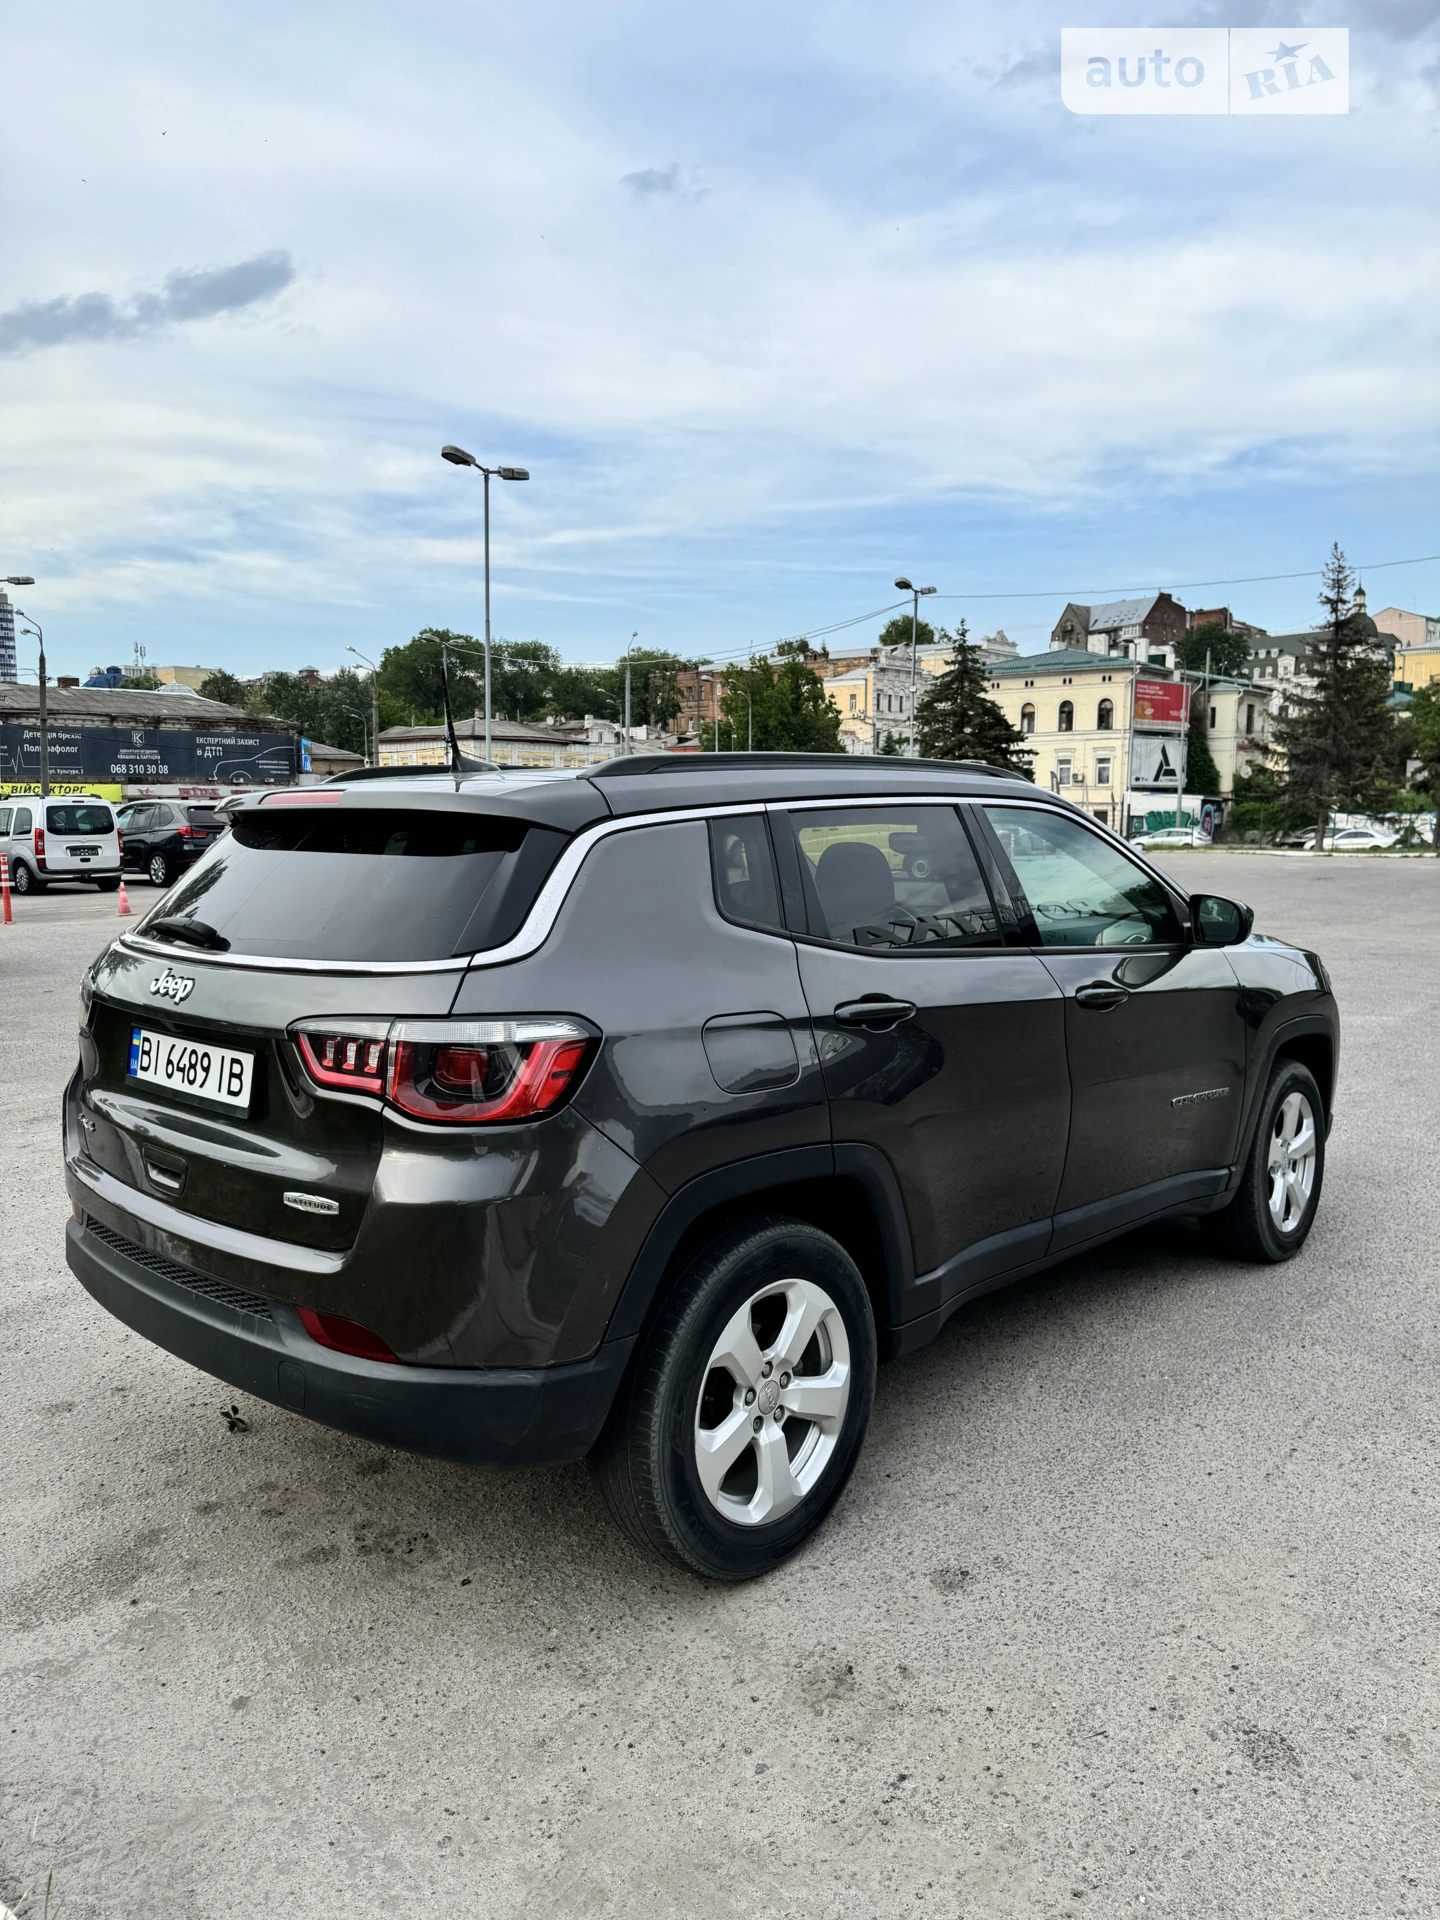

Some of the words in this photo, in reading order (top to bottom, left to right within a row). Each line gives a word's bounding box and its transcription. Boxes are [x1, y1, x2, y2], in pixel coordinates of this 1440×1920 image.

[23, 730, 57, 740] Детеція
[196, 736, 236, 746] ЕКСПЕРТНИЙ
[236, 738, 260, 746] ЗАХИСТ
[24, 744, 79, 754] Полафолог
[204, 746, 223, 759] ДТП
[110, 764, 127, 774] 068
[128, 764, 145, 774] 310
[146, 764, 157, 774] 30
[158, 764, 169, 774] 08
[10, 784, 86, 794] ВІЙСКТОРГ
[150, 968, 195, 1005] Jeep
[130, 1058, 138, 1070] UA
[139, 1036, 160, 1075] BI
[165, 1044, 212, 1088] 6489
[218, 1055, 244, 1097] IB
[287, 1196, 334, 1211] LATITUDE
